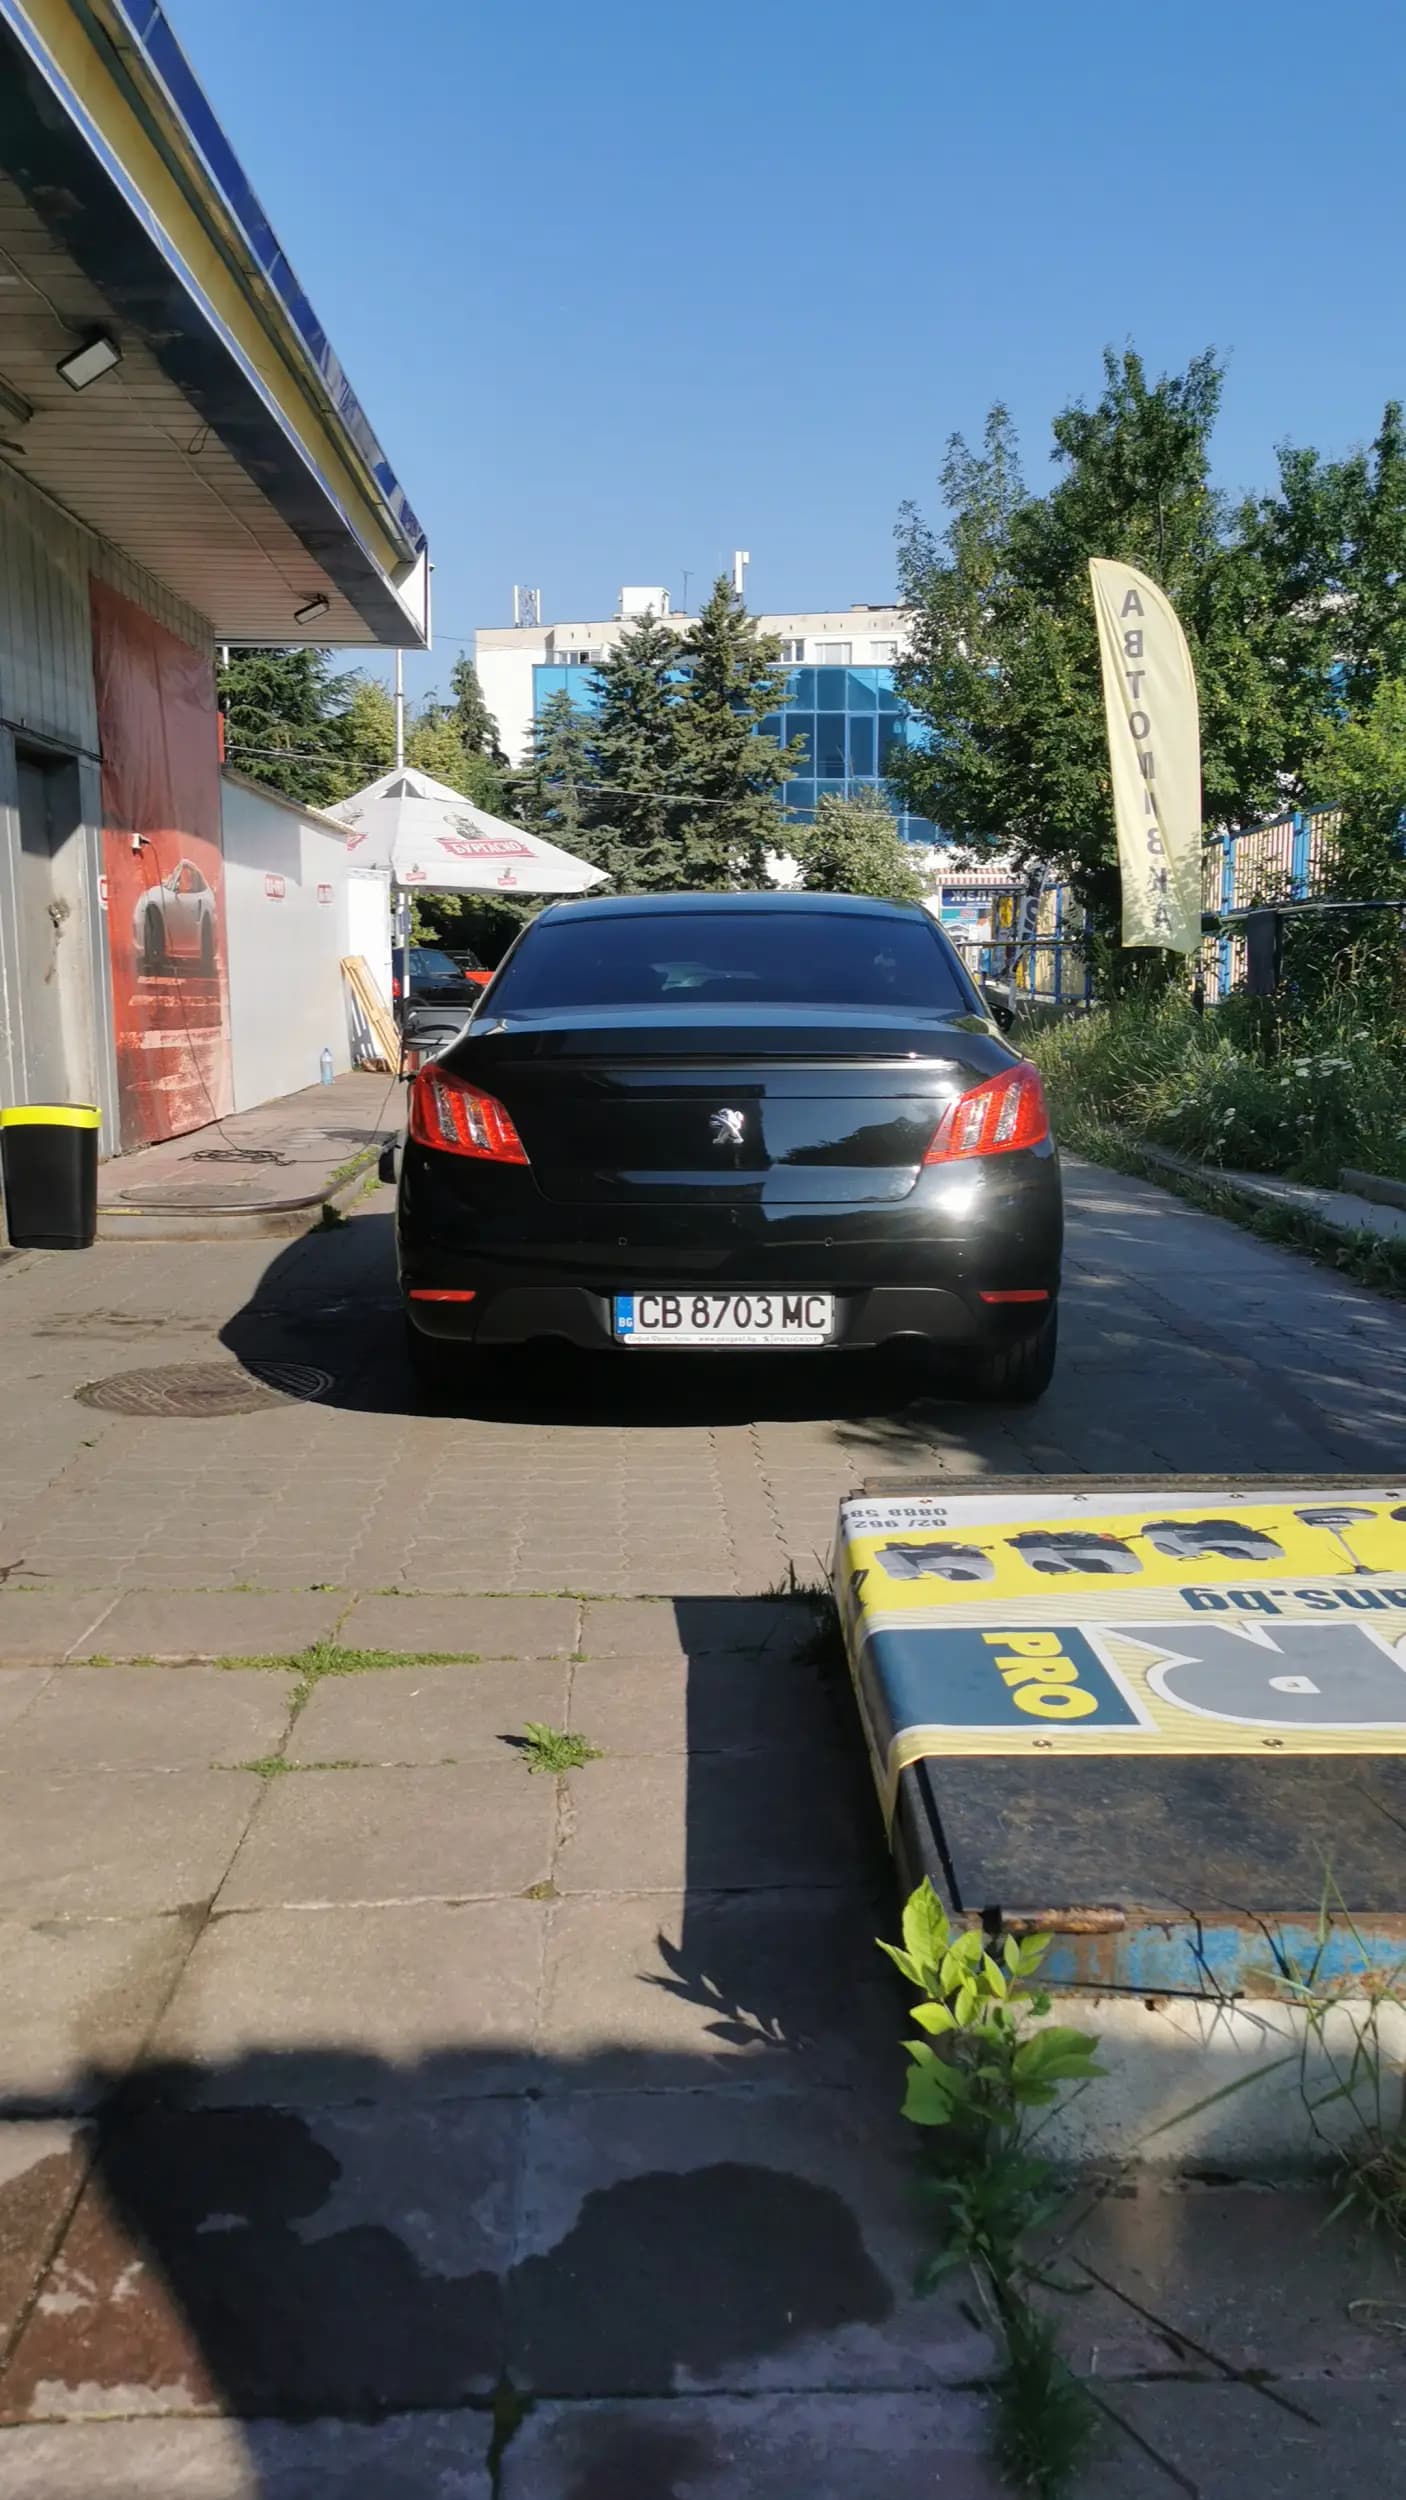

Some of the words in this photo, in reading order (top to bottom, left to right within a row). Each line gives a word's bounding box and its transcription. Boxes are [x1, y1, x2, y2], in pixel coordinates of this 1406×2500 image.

[691, 1296, 773, 1329] 8703
[618, 1317, 633, 1327] BG
[887, 1508, 948, 1517] 0888
[853, 1519, 899, 1528] 962
[908, 1519, 947, 1527] 02/
[981, 1631, 1099, 1720] PRO
